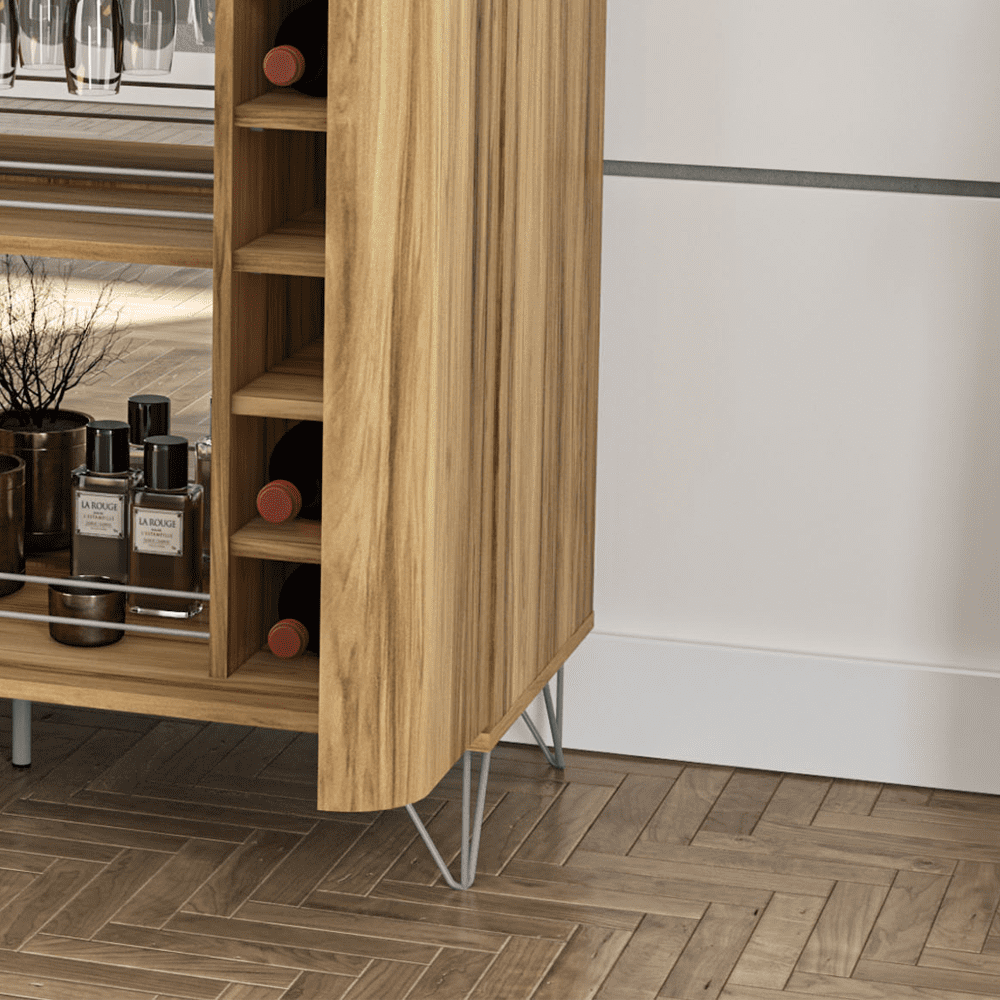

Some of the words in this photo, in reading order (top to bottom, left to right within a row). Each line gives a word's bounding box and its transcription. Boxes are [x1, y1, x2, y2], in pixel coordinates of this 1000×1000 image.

[81, 500, 90, 510] LA
[91, 501, 118, 512] ROUGE
[138, 518, 148, 527] LA
[149, 518, 176, 528] ROUGE
